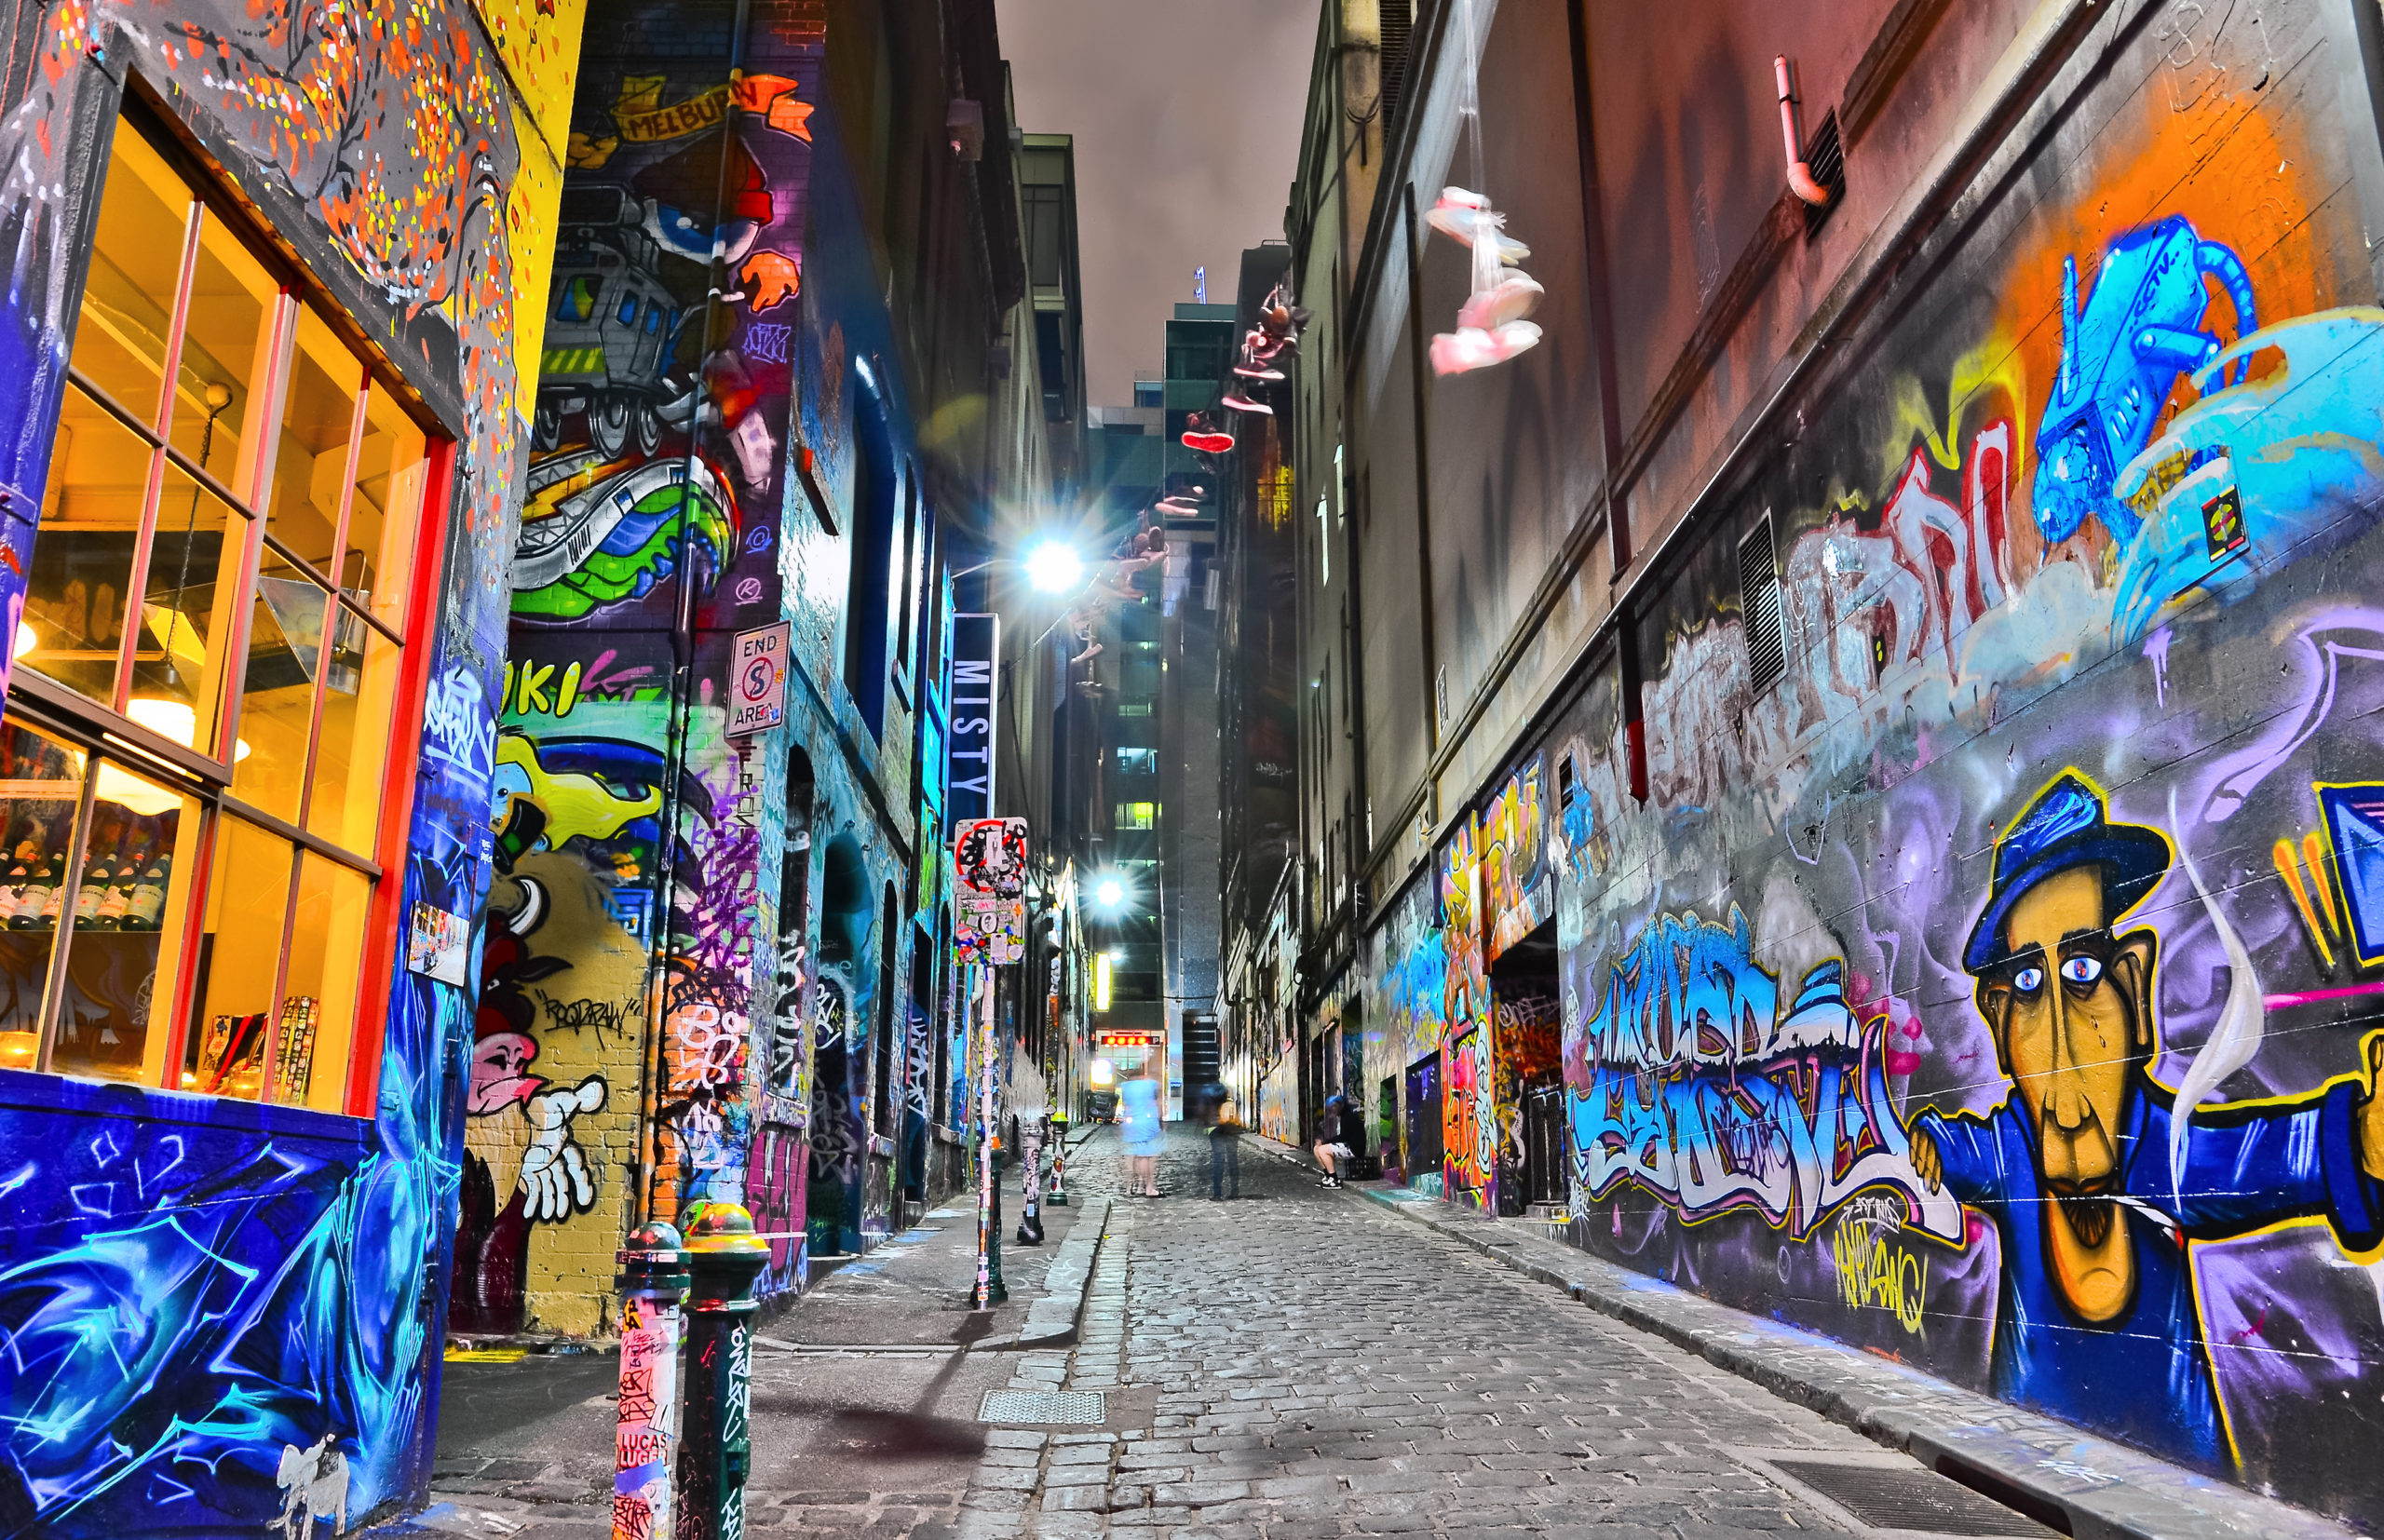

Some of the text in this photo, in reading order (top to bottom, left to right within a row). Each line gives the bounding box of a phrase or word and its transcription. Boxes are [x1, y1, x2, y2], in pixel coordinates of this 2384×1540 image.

[743, 635, 778, 657] END
[950, 659, 991, 795] MISTY
[621, 1433, 667, 1451] LUCAS
